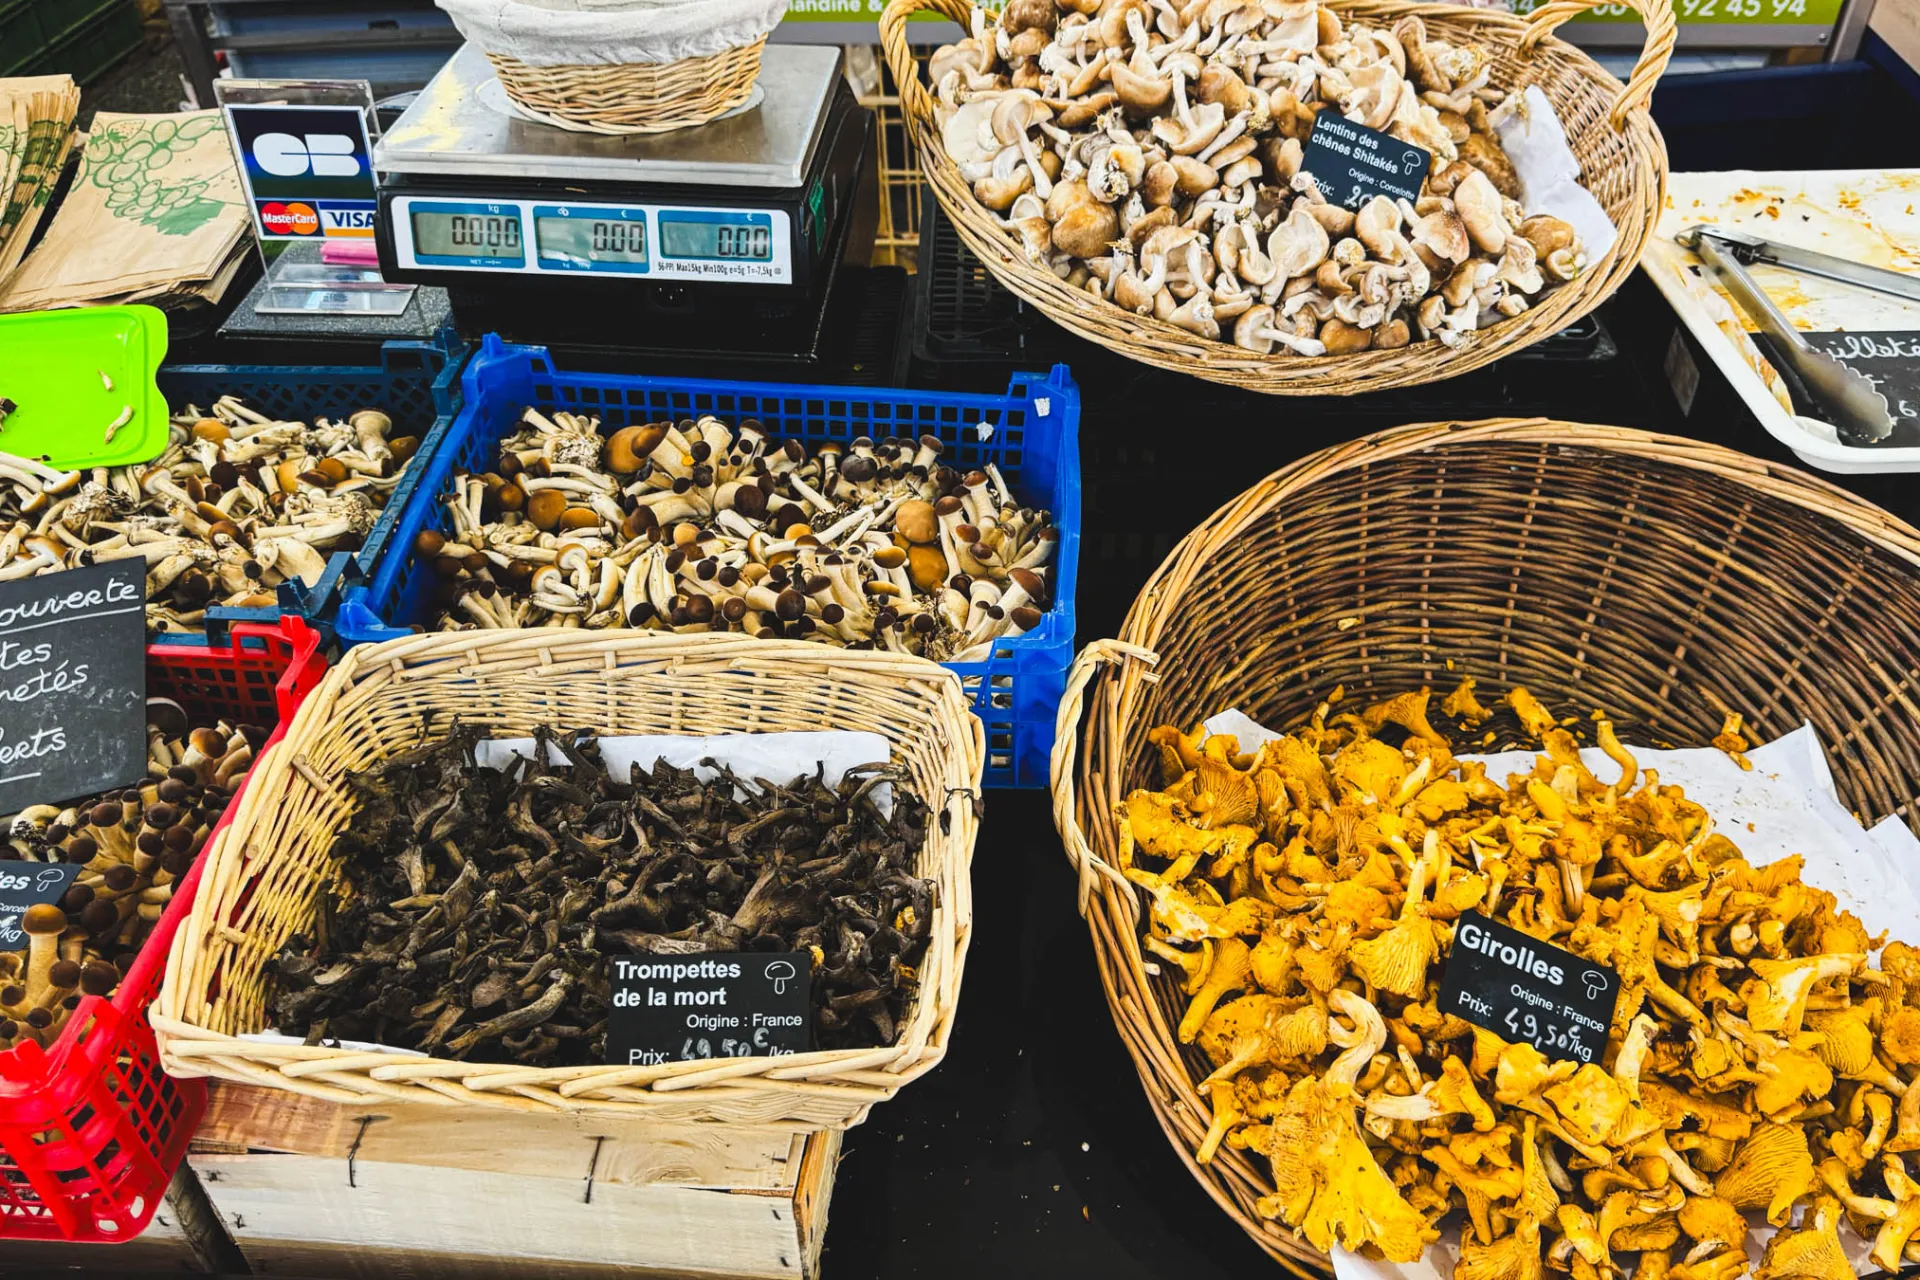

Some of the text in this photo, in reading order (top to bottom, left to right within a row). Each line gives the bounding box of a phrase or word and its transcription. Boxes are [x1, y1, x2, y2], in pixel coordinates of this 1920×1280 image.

[787, 0, 861, 12] landine
[1682, 0, 1716, 16] 92
[1725, 0, 1761, 17] 45
[1772, 0, 1806, 17] 94
[1316, 116, 1379, 150] Lentins des
[1312, 133, 1398, 174] chênes Shitakés
[1348, 168, 1375, 185] Origine
[263, 212, 317, 226] MasterCard
[488, 204, 500, 214] kg
[452, 216, 518, 247] 0.000
[593, 223, 643, 253] 0.00
[718, 227, 768, 257] 0.00
[0, 577, 140, 627] ouverte
[0, 641, 52, 670] tes
[0, 727, 66, 764] erts
[1459, 923, 1565, 986] Girolles
[615, 959, 741, 983] Trompettes
[613, 986, 727, 1007] de la mort
[1458, 990, 1494, 1018] Prix:
[1510, 984, 1554, 1011] Origine
[1562, 1006, 1605, 1033] France
[686, 1013, 740, 1031] Origine
[752, 1012, 803, 1027] France
[628, 1048, 671, 1065] Prix:
